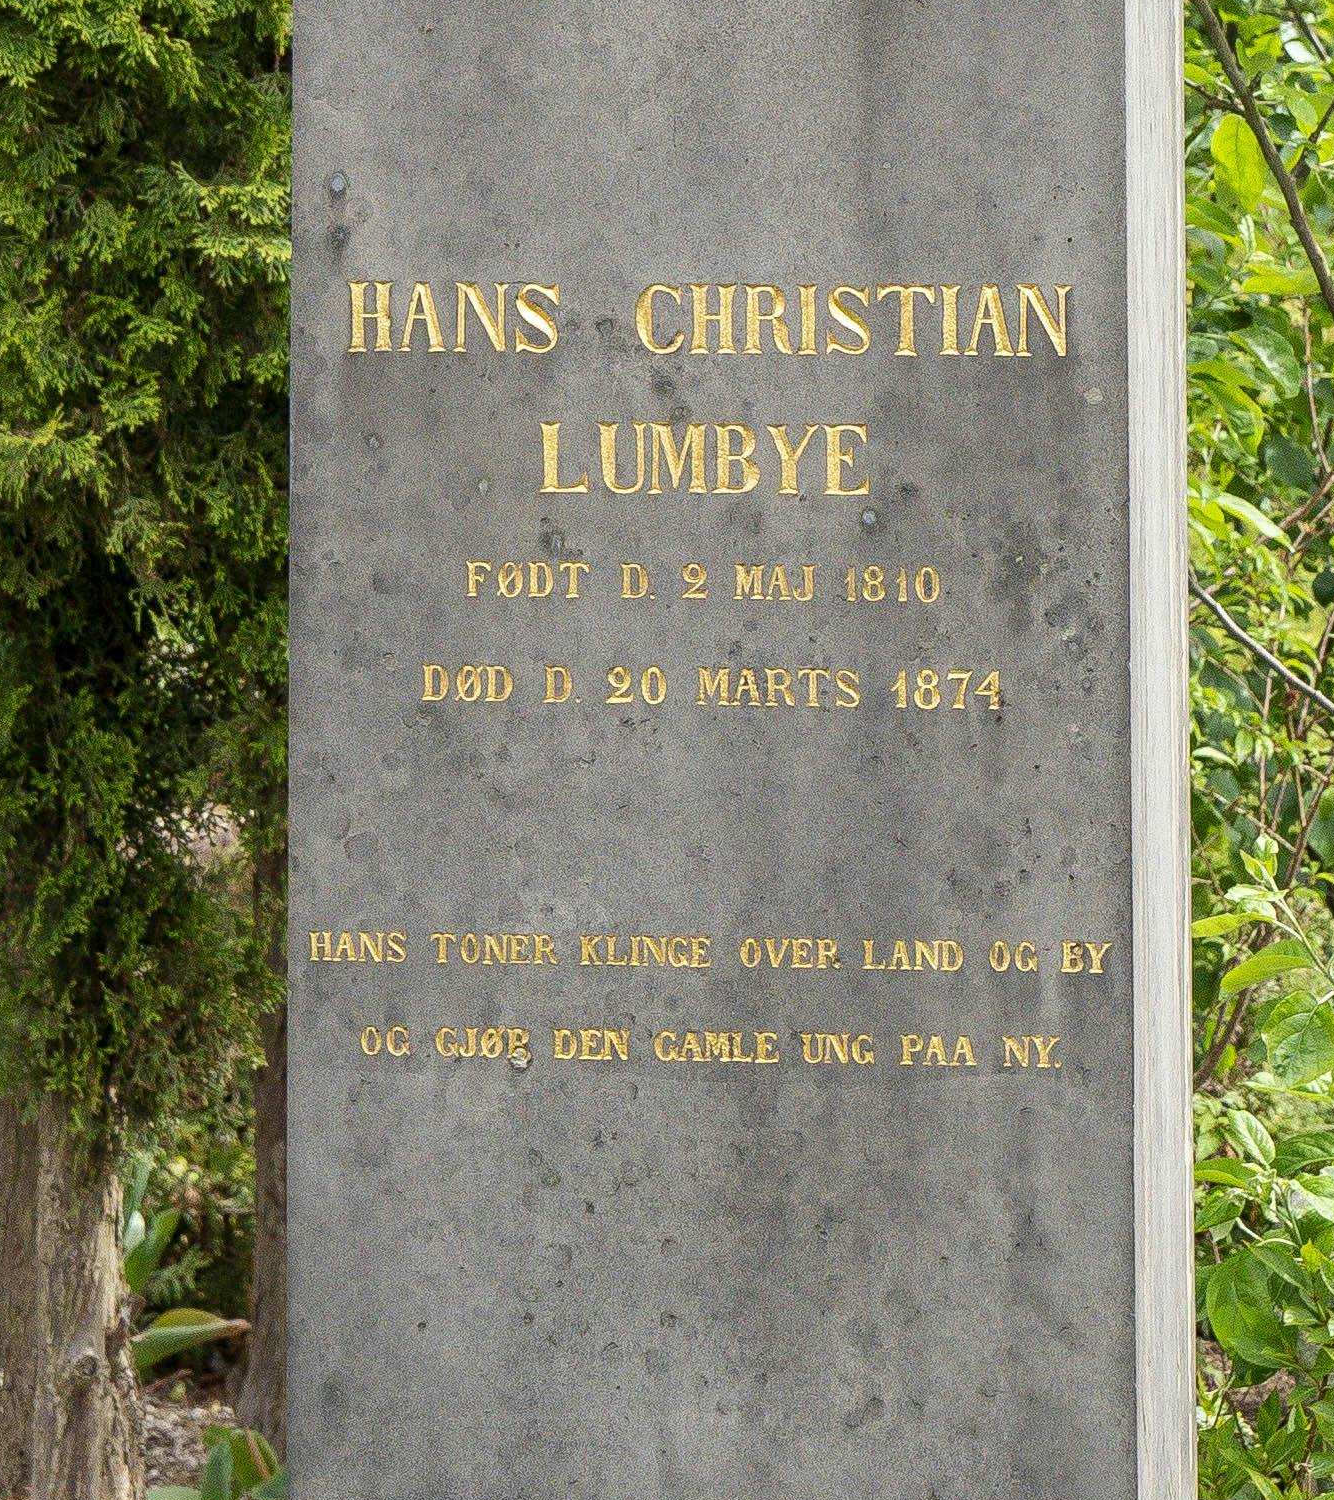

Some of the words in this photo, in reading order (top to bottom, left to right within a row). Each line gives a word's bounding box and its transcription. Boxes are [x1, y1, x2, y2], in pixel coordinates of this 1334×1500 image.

[347, 279, 561, 354] HANS
[633, 281, 1072, 358] CHRISTIAN
[539, 419, 872, 497] LUMBYE
[466, 558, 591, 600] FØDT
[620, 562, 655, 600] D.
[681, 562, 709, 600] 2
[733, 561, 817, 602] MAJ
[844, 564, 942, 604] 1810
[421, 662, 515, 703] DØD
[543, 663, 581, 704] D.
[605, 664, 668, 706] 20
[696, 666, 862, 709] MARTS
[891, 666, 1002, 711] 1874
[308, 929, 408, 964] HANS
[429, 930, 559, 967] TONER
[579, 933, 713, 970] KLINGE
[738, 935, 841, 970] OVER
[861, 937, 965, 973] LAND
[988, 939, 1039, 972] OG
[1060, 938, 1112, 975] BY
[358, 1024, 411, 1057] OG
[434, 1024, 531, 1061] GJØR
[552, 1026, 631, 1062] DEN
[652, 1028, 781, 1065] GAMLE
[800, 1030, 876, 1066] UNG
[900, 1032, 978, 1068] PAA
[1002, 1033, 1062, 1070] NY.
